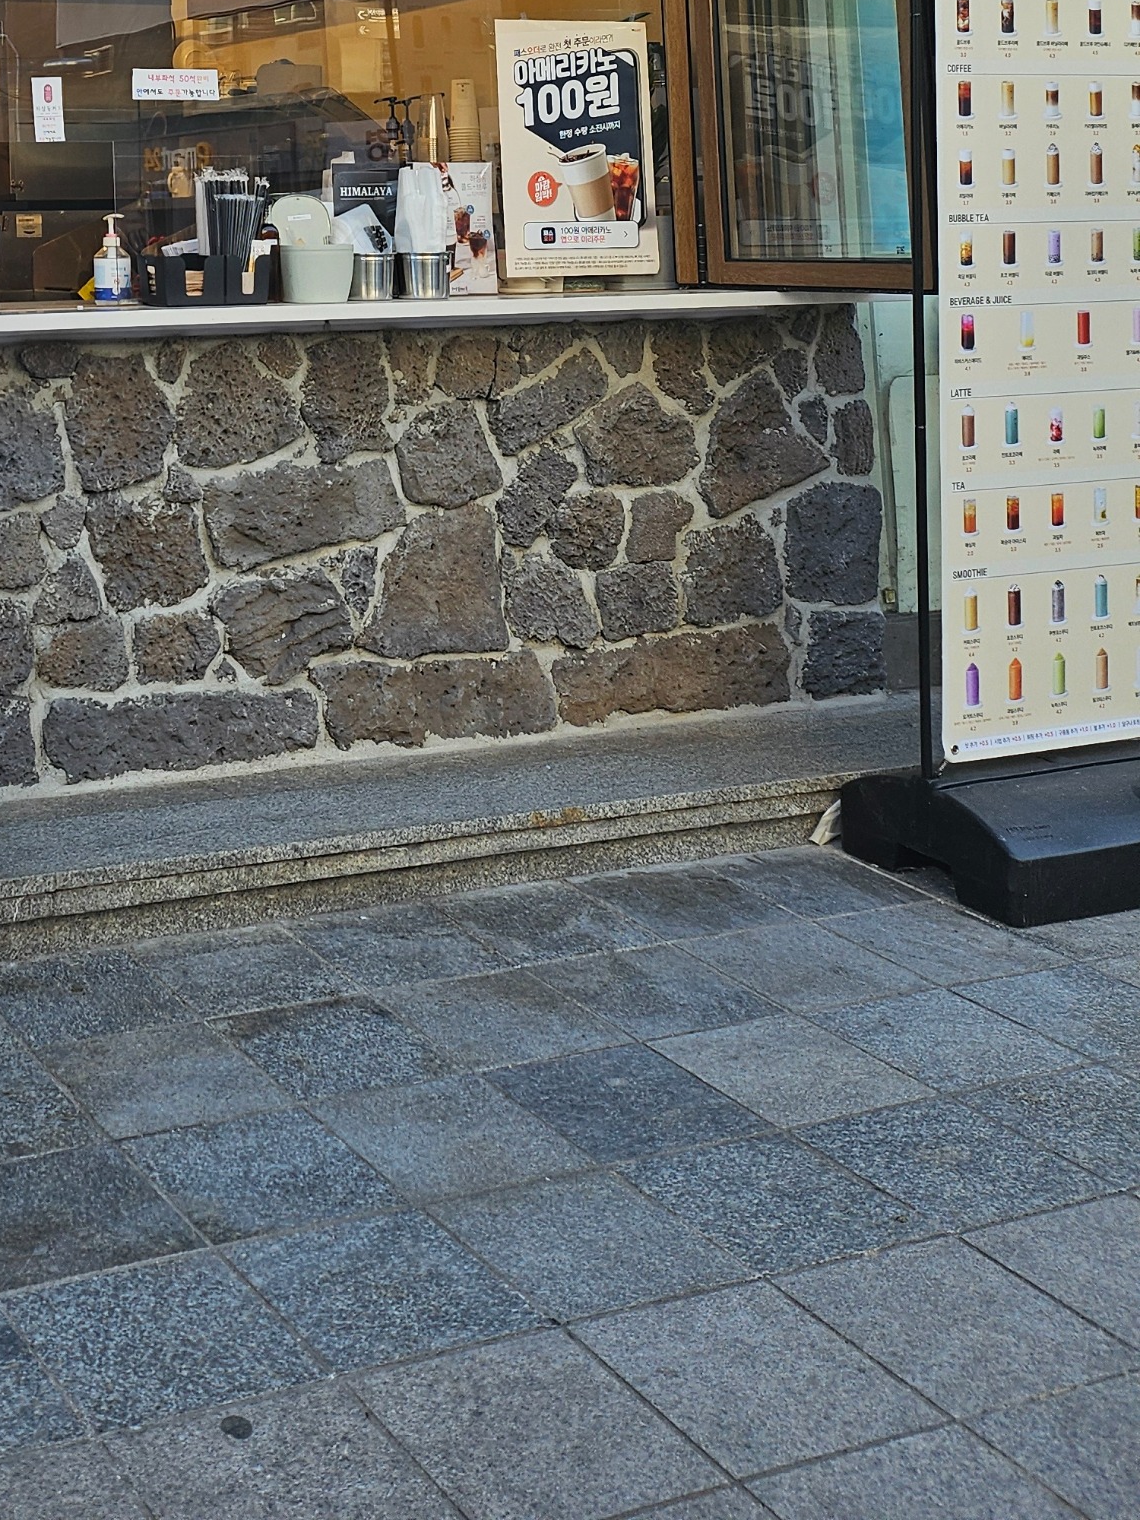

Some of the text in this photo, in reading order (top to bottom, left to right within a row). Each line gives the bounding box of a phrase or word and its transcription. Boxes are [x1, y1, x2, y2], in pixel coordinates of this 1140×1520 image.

[514, 47, 618, 85] 아메리카노
[947, 64, 972, 73] COFFEE
[515, 71, 620, 127] 100원
[340, 185, 393, 197] HIMALAYA
[948, 213, 989, 223] BUBBLE TEA
[949, 296, 984, 306] BEVERAGE
[992, 295, 1012, 305] JUICE
[950, 388, 972, 398] LATTE
[951, 481, 966, 491] TEA
[952, 568, 988, 580] SMOOTHIE
